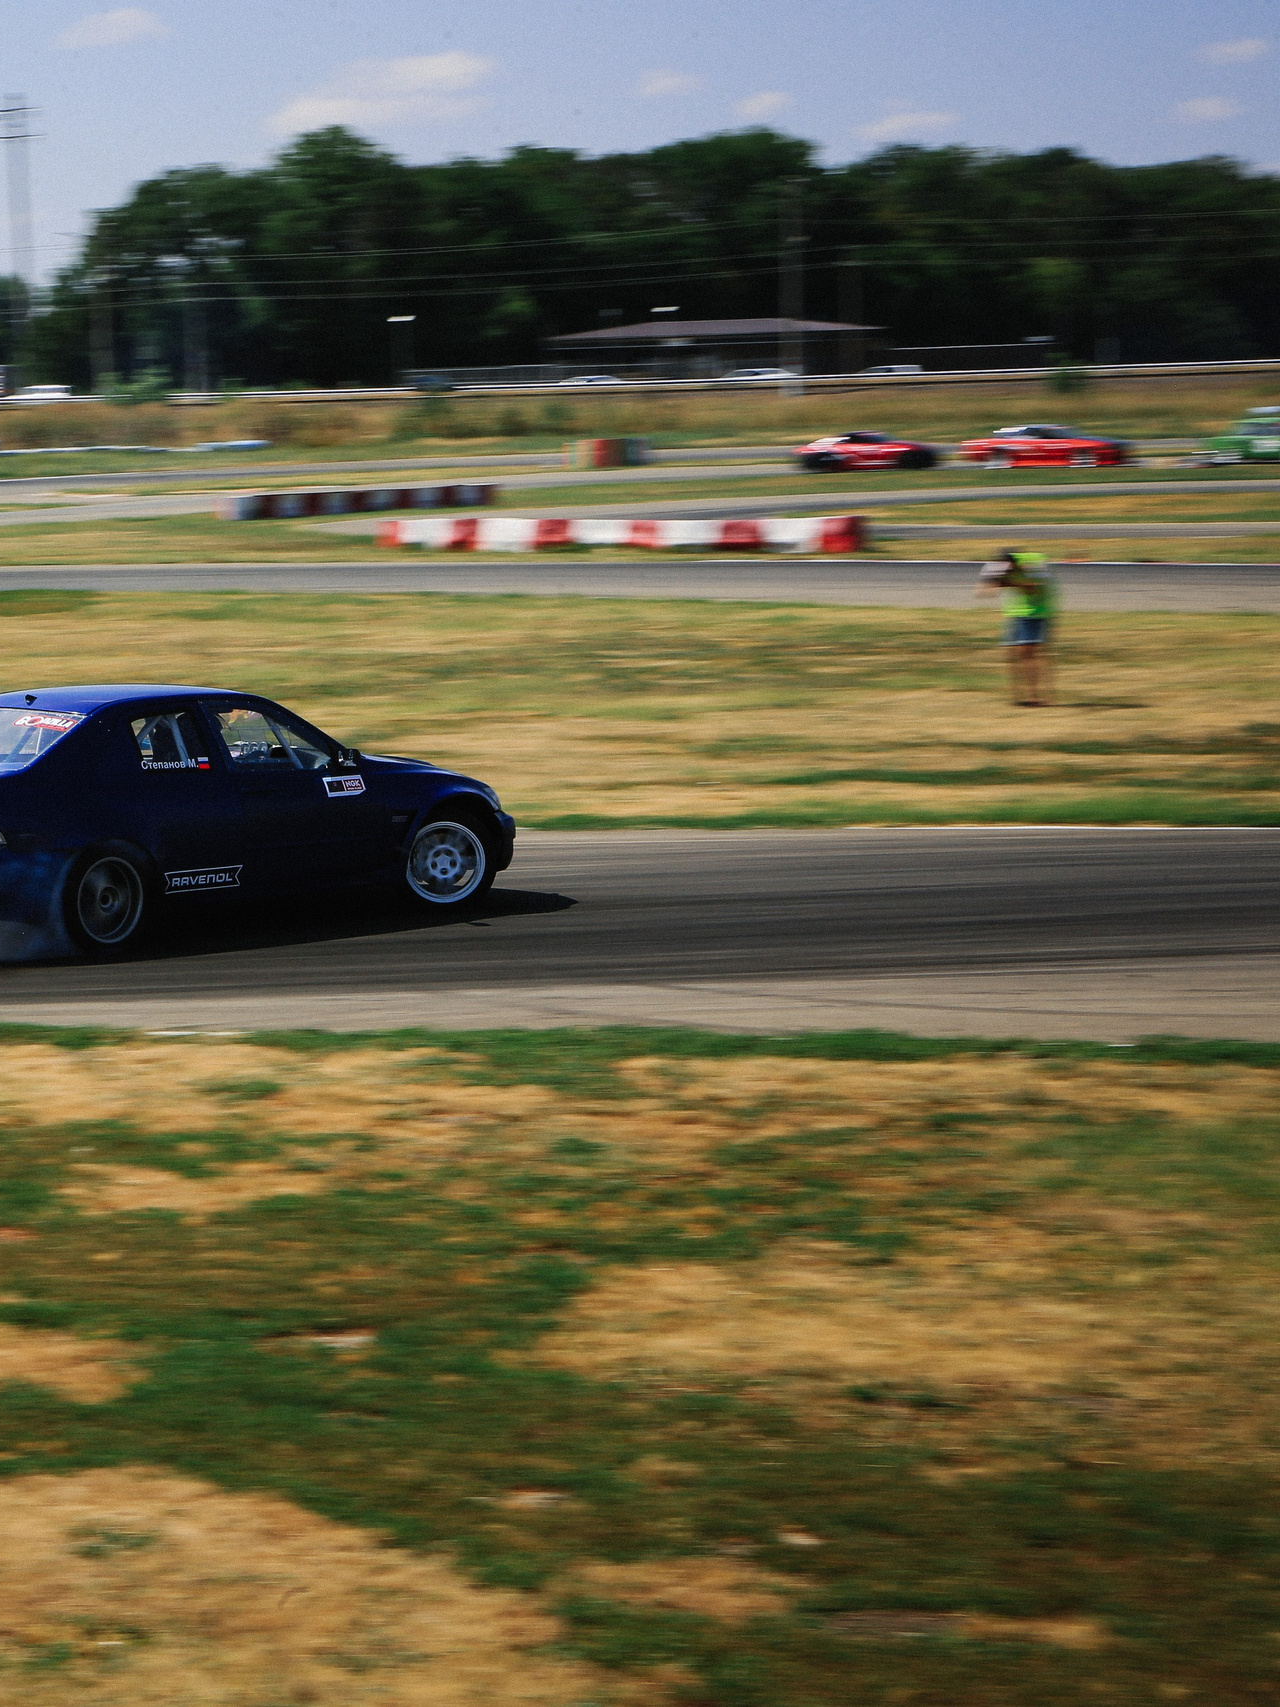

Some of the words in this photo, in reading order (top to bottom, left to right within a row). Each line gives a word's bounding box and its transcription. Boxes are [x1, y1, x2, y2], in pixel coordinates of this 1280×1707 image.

[140, 760, 186, 770] Степанов
[188, 758, 199, 768] М.
[345, 780, 361, 788] NGK
[171, 873, 233, 887] RAVENOL
